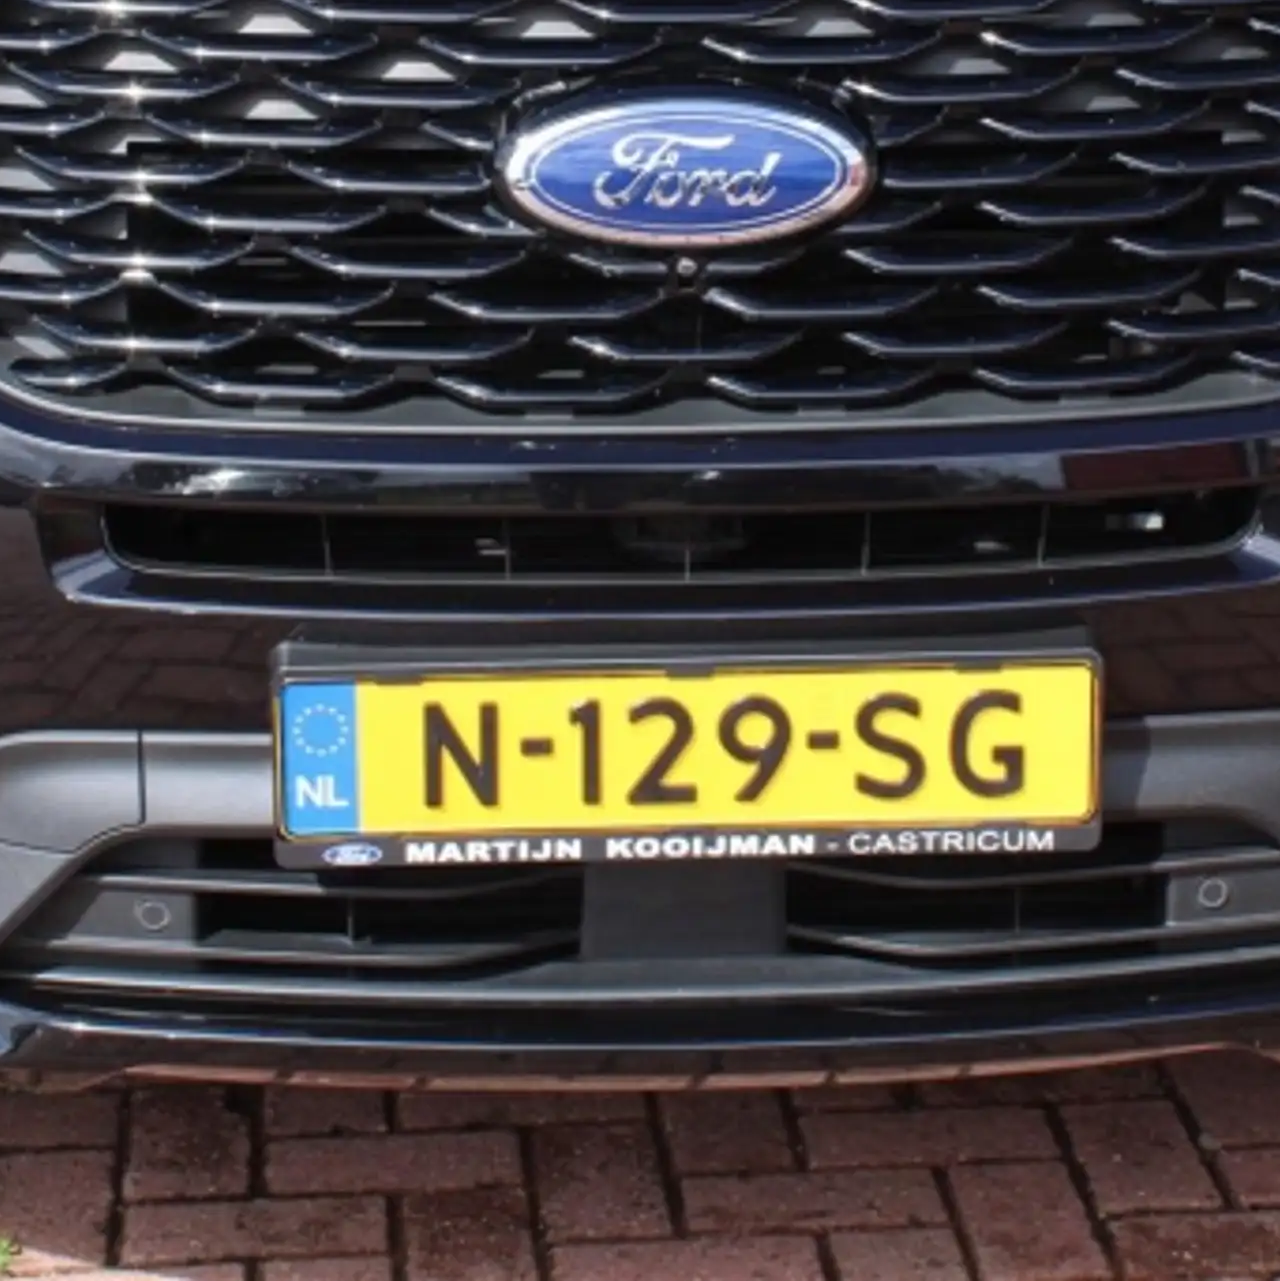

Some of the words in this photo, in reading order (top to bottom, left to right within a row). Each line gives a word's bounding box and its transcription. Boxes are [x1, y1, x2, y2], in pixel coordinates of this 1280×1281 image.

[594, 132, 783, 209] Ford
[423, 689, 1026, 809] N-129-SG
[295, 775, 350, 809] NL
[405, 839, 583, 864] MARTIJN
[606, 834, 816, 859] KOOIJMAN
[847, 829, 1055, 854] CASTRICUM
